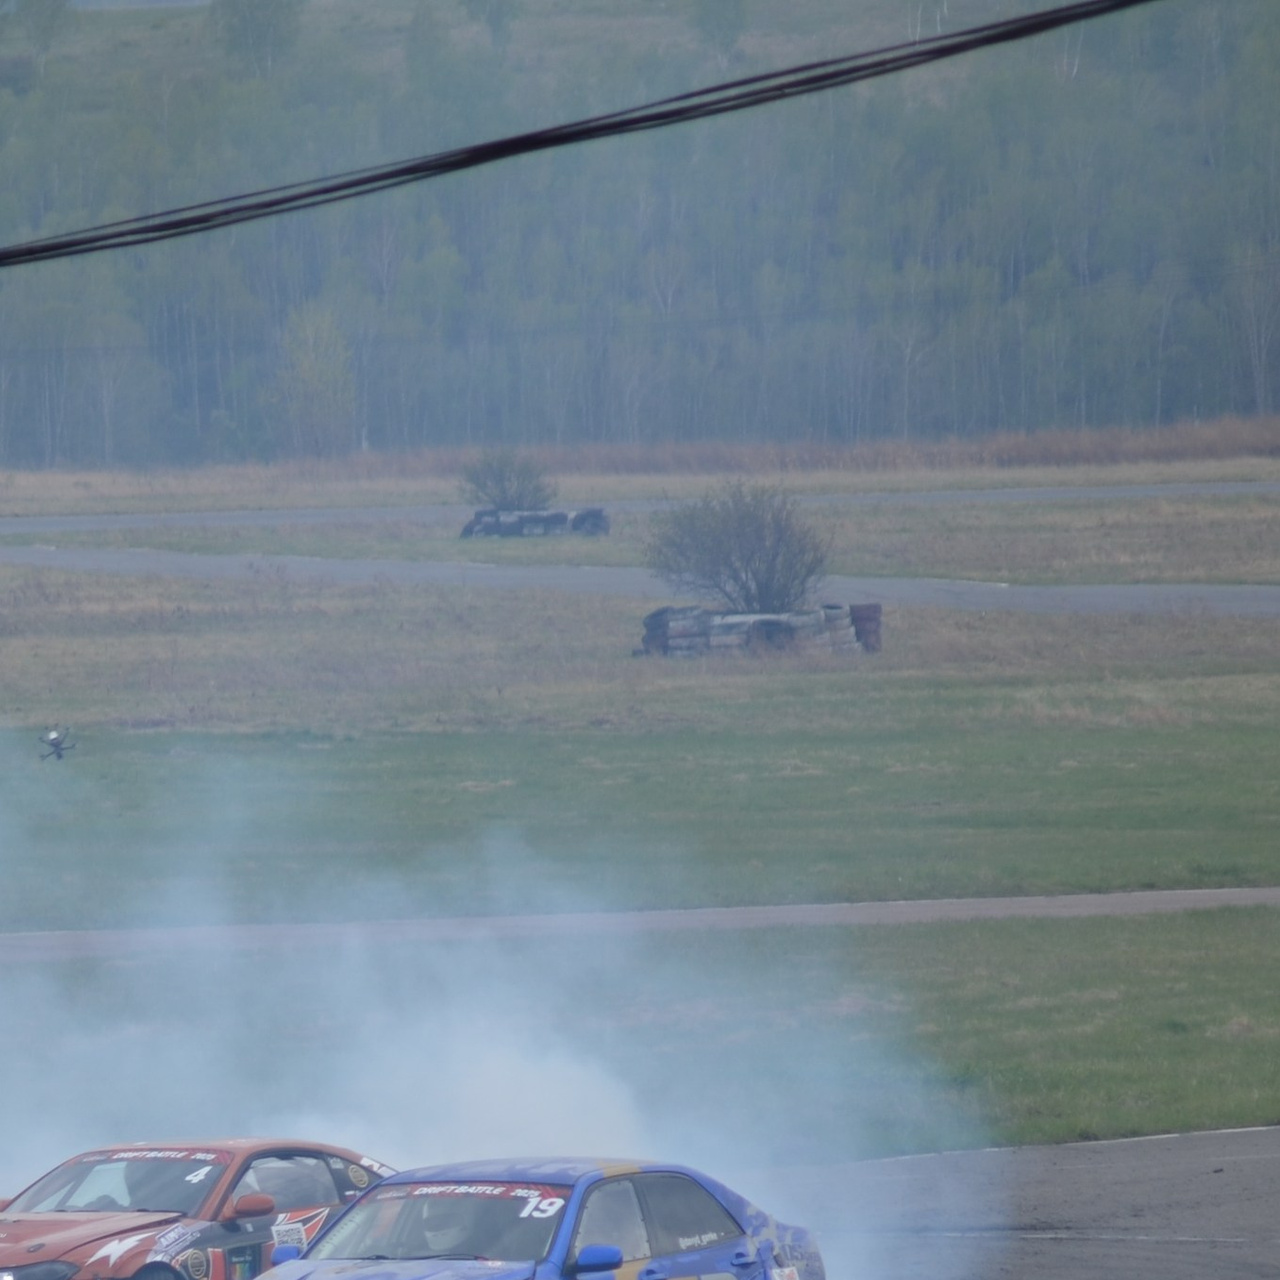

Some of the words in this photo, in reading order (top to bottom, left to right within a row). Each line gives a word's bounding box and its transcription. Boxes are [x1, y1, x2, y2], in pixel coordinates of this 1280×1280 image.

[184, 1166, 213, 1183] 4
[413, 1186, 455, 1195] DRIFT
[453, 1186, 507, 1195] BATTLE
[510, 1188, 543, 1197] 2025
[519, 1197, 565, 1218] 19
